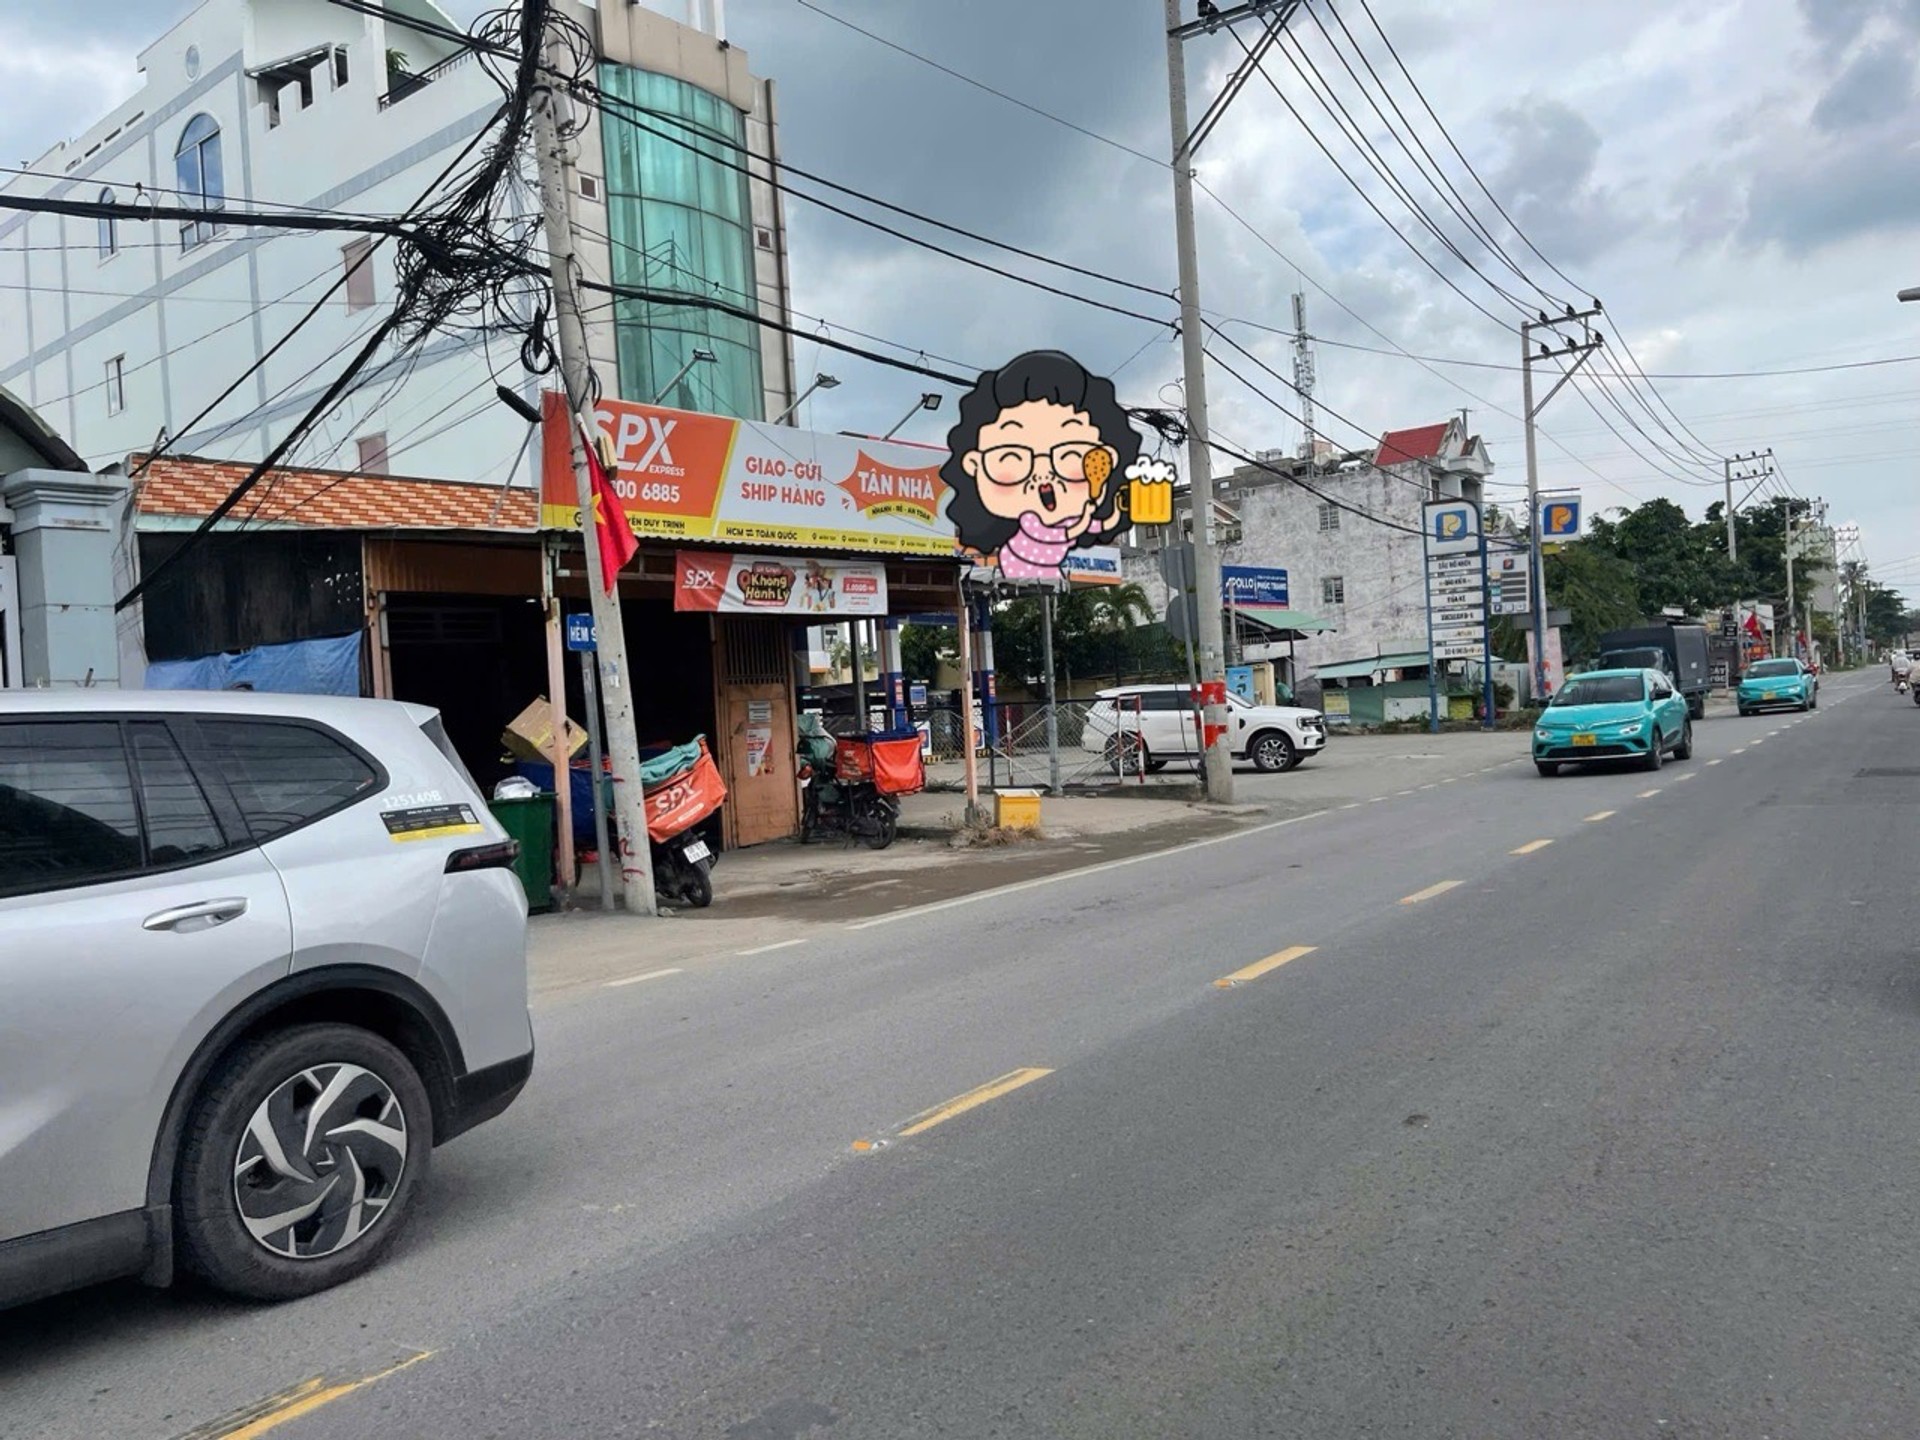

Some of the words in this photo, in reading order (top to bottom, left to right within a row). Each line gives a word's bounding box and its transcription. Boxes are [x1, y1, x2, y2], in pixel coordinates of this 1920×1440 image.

[649, 464, 686, 477] EXPRESS
[642, 482, 681, 504] 6885
[741, 482, 777, 502] SHIP
[781, 484, 825, 507] HÀNG
[858, 467, 895, 497] TẬN
[898, 474, 935, 501] NHÀ
[644, 518, 661, 528] DUY
[662, 520, 686, 529] TRINH
[727, 527, 744, 541] HCM
[756, 530, 774, 544] TOÀN
[777, 531, 798, 546] QUỐC
[686, 569, 717, 590] SPX
[570, 621, 589, 642] HẺM
[383, 790, 442, 809] 125140B
